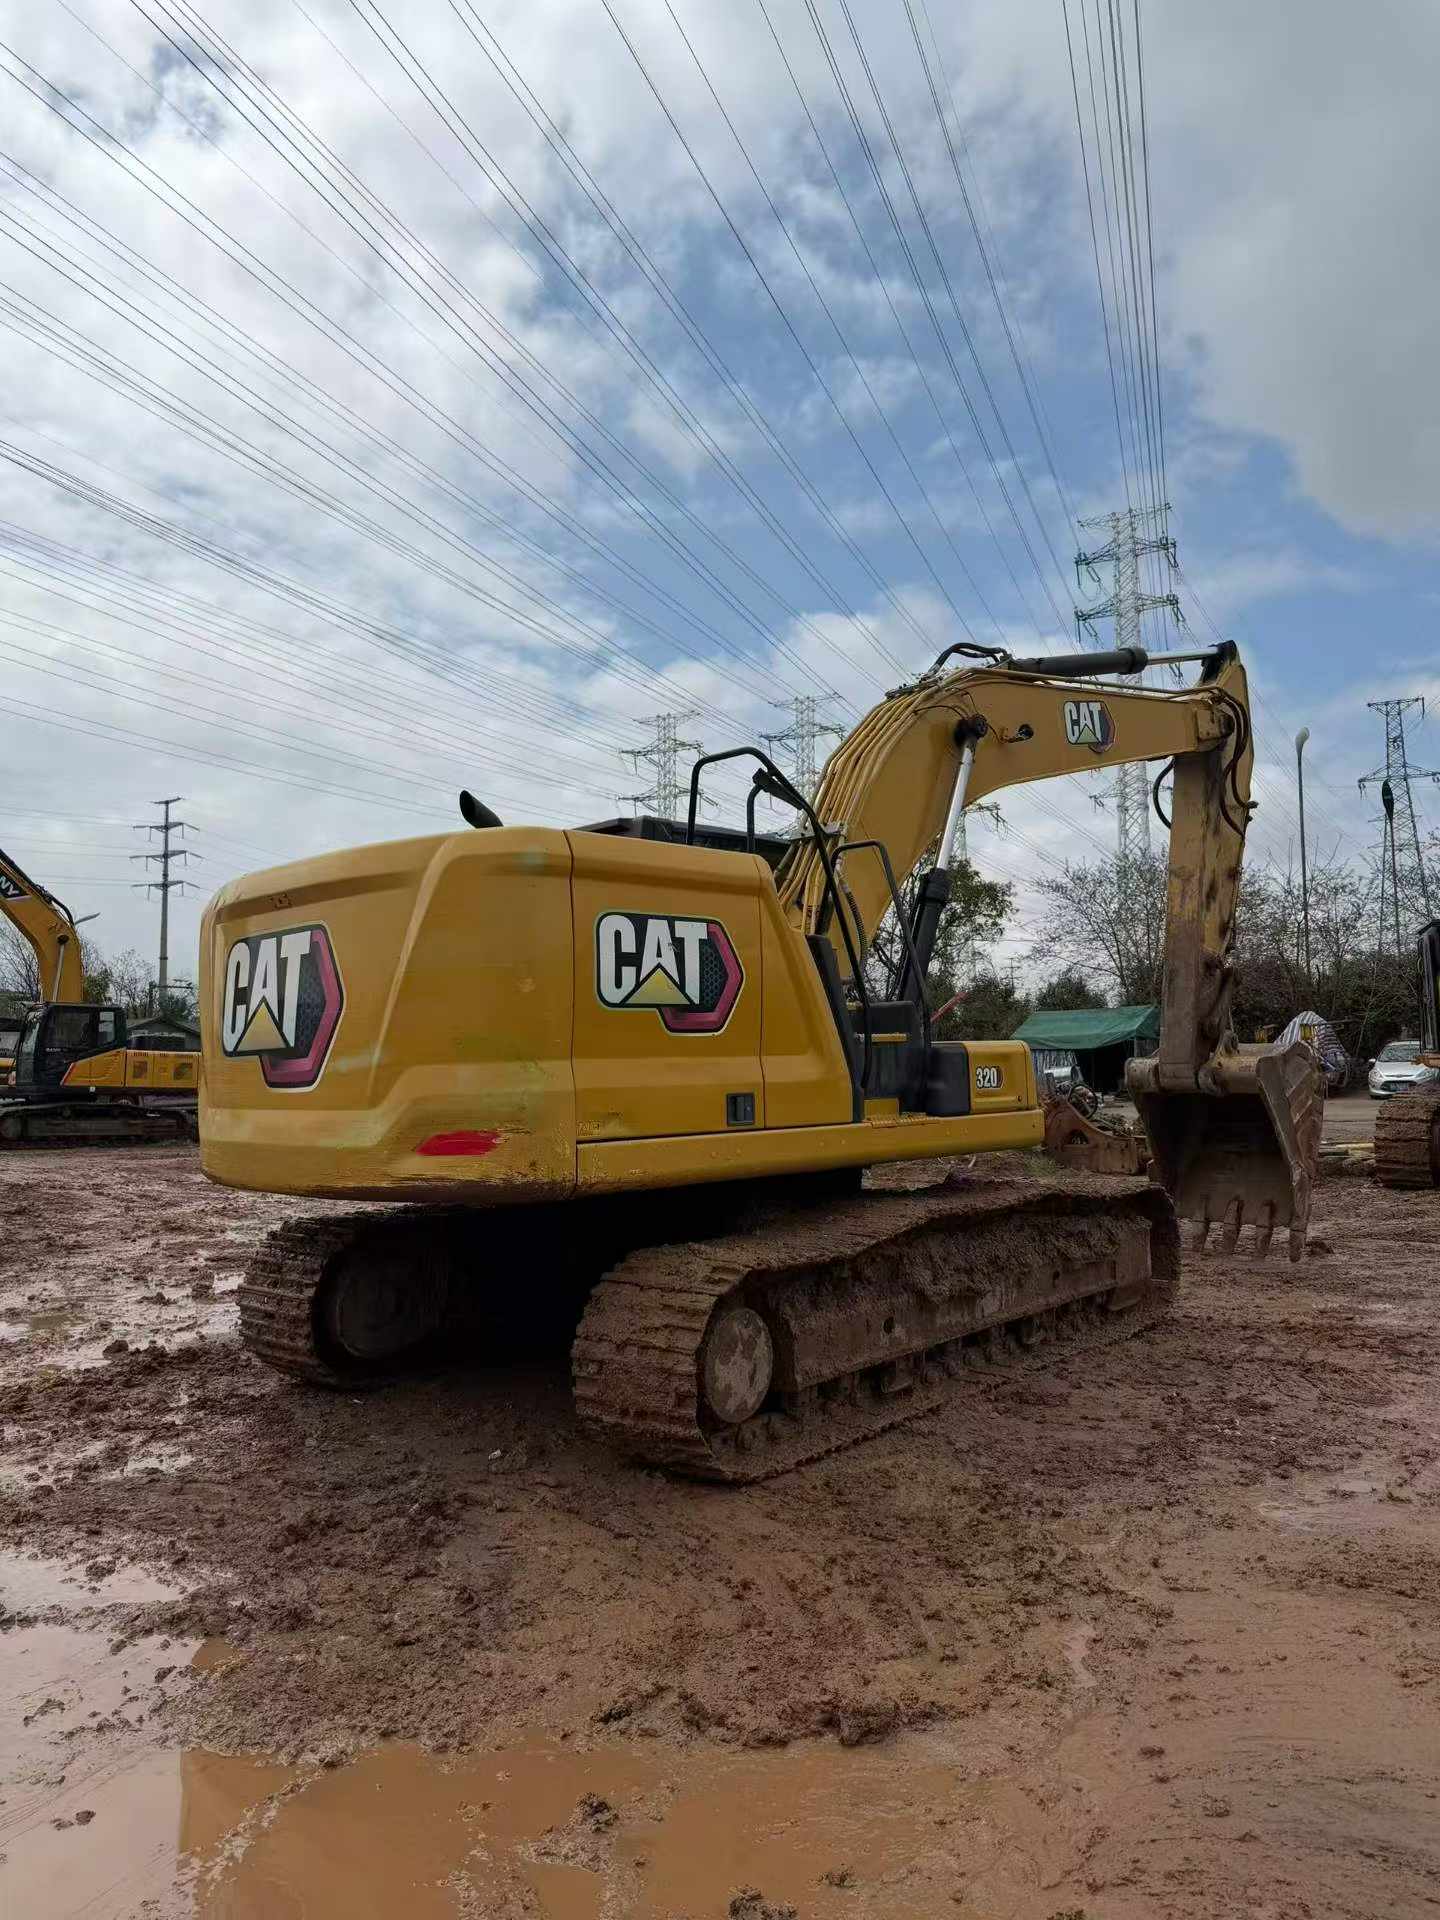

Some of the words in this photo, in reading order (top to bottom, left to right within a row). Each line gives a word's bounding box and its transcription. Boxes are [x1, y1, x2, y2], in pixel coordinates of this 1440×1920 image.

[1064, 702, 1102, 744] CAT
[223, 930, 312, 1051] CAT
[599, 914, 708, 1005] CAT
[976, 1066, 998, 1089] 320
